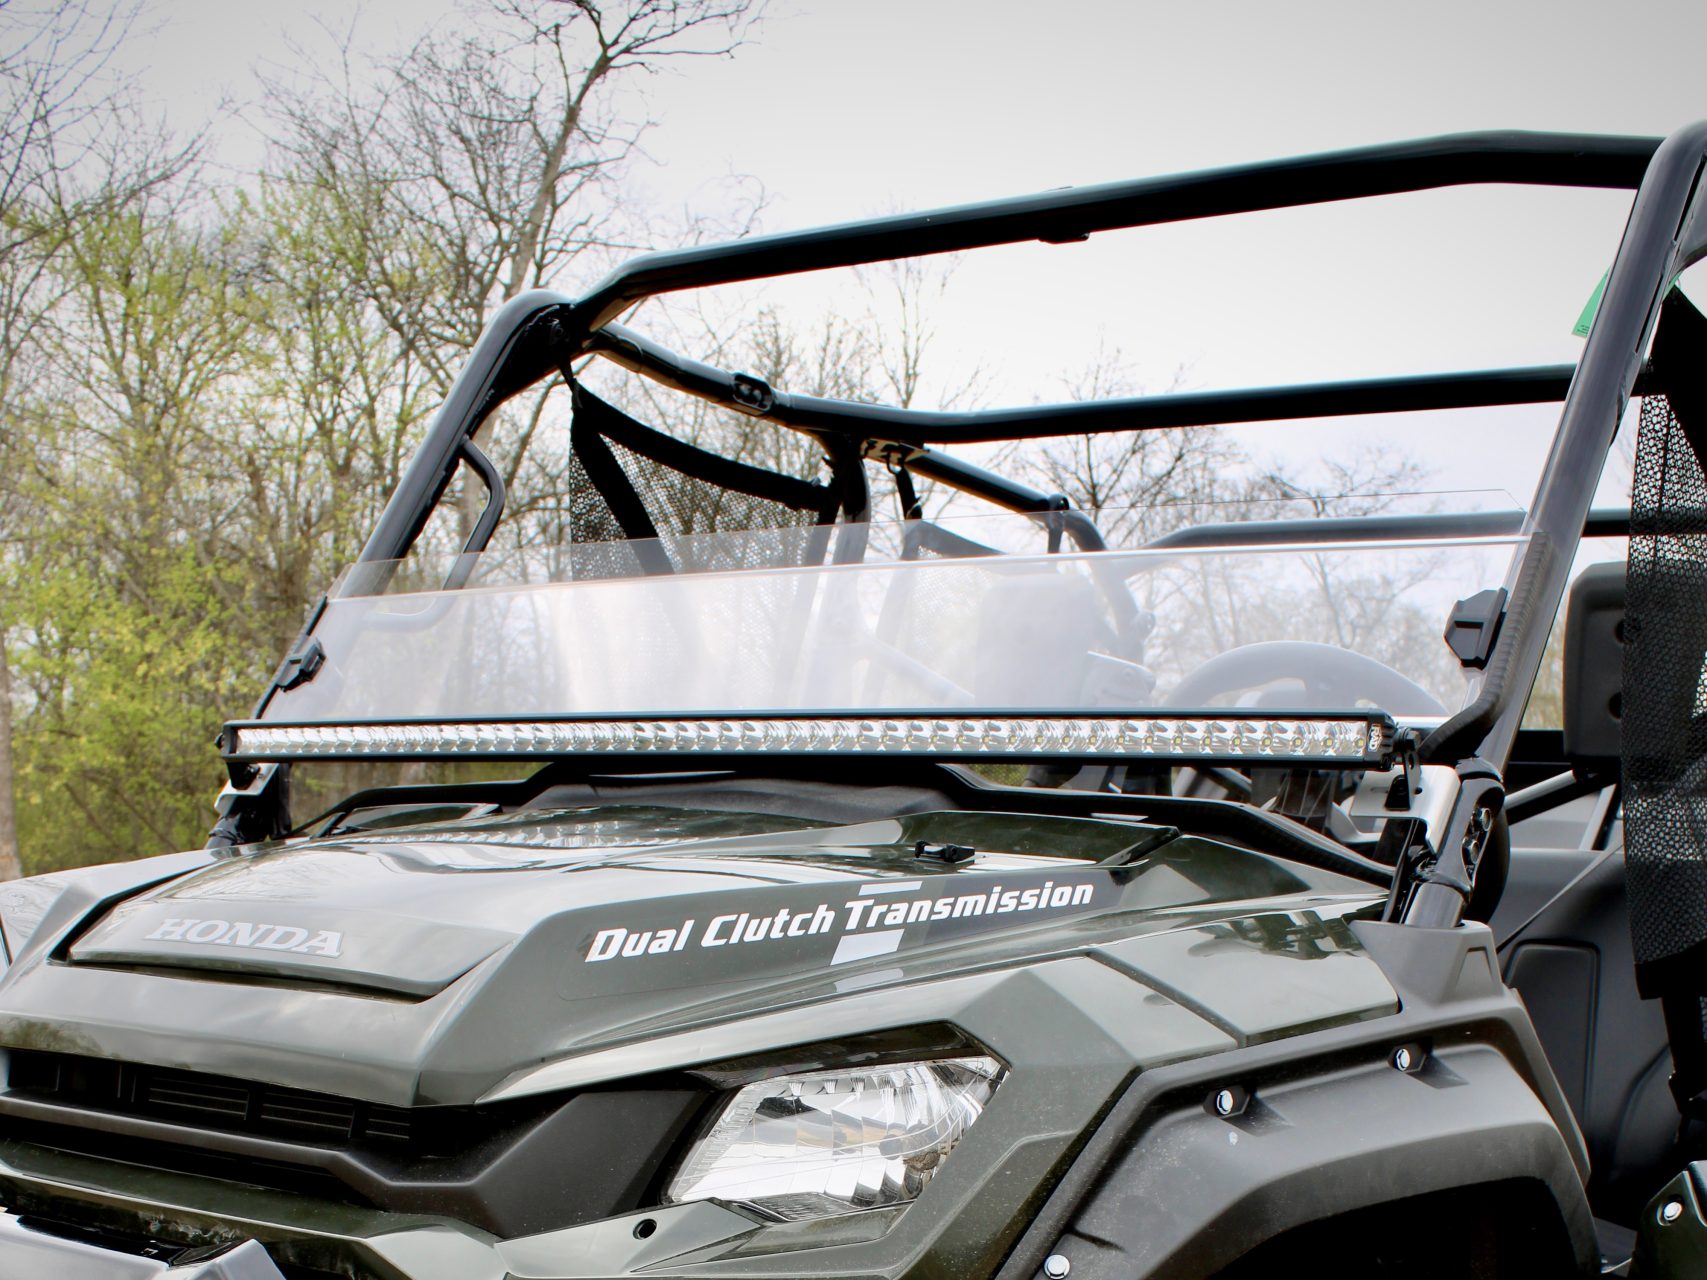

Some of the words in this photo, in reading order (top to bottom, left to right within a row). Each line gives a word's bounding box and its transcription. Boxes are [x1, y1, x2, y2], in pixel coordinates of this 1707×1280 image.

[145, 918, 344, 958] HONDA
[585, 919, 694, 962] Dual
[700, 899, 835, 948] Clutch
[844, 881, 1093, 931] Transmission
